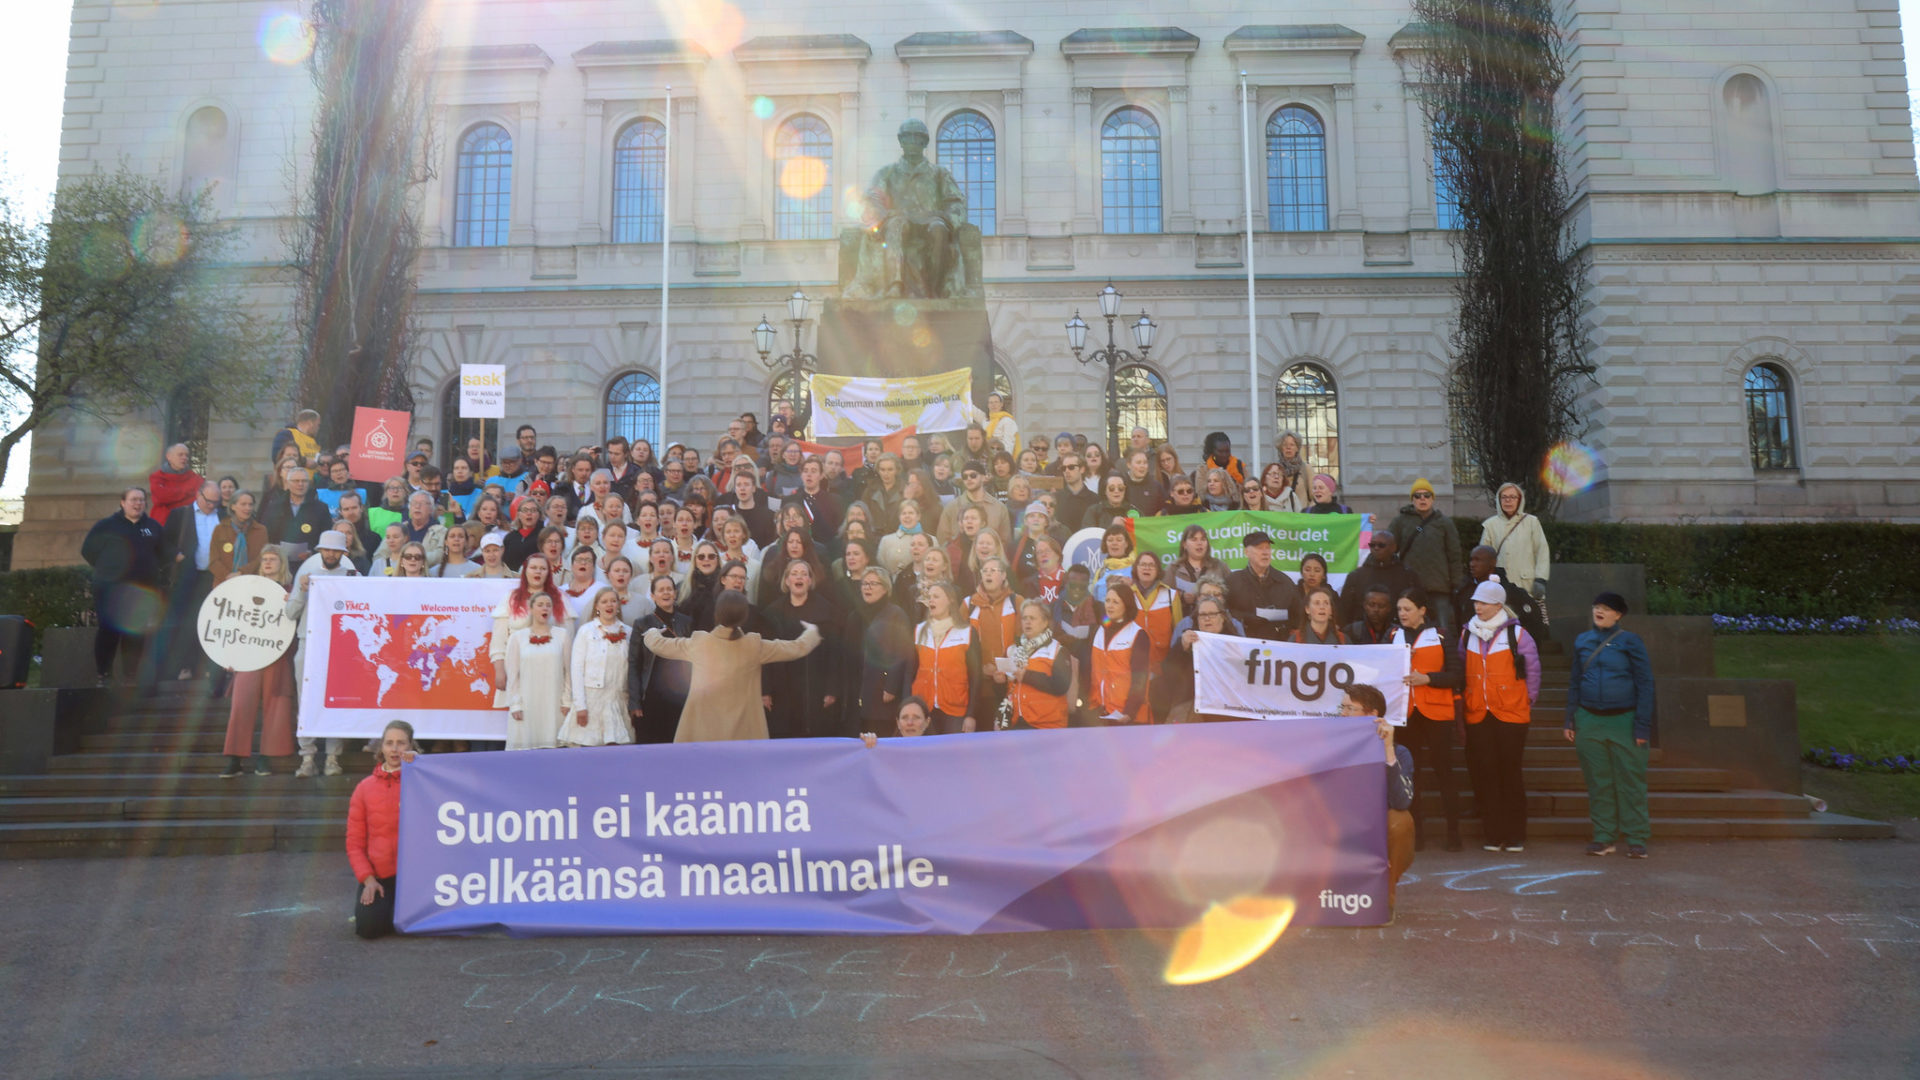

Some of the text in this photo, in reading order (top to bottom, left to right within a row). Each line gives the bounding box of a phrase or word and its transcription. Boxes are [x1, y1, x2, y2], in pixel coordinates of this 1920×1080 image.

[462, 372, 502, 386] sask
[825, 394, 960, 408] Reilumman maailman puolesta
[213, 596, 285, 629] Yhteiset
[345, 601, 370, 611] YMCA
[421, 604, 459, 612] Welcome
[472, 604, 486, 612] the
[204, 619, 285, 652] Lapsemme
[1244, 648, 1355, 702] fingo
[436, 788, 811, 846] Suomi ei käännä
[434, 845, 949, 907] selkäänsä maailmalle.
[1318, 889, 1373, 915] fingo
